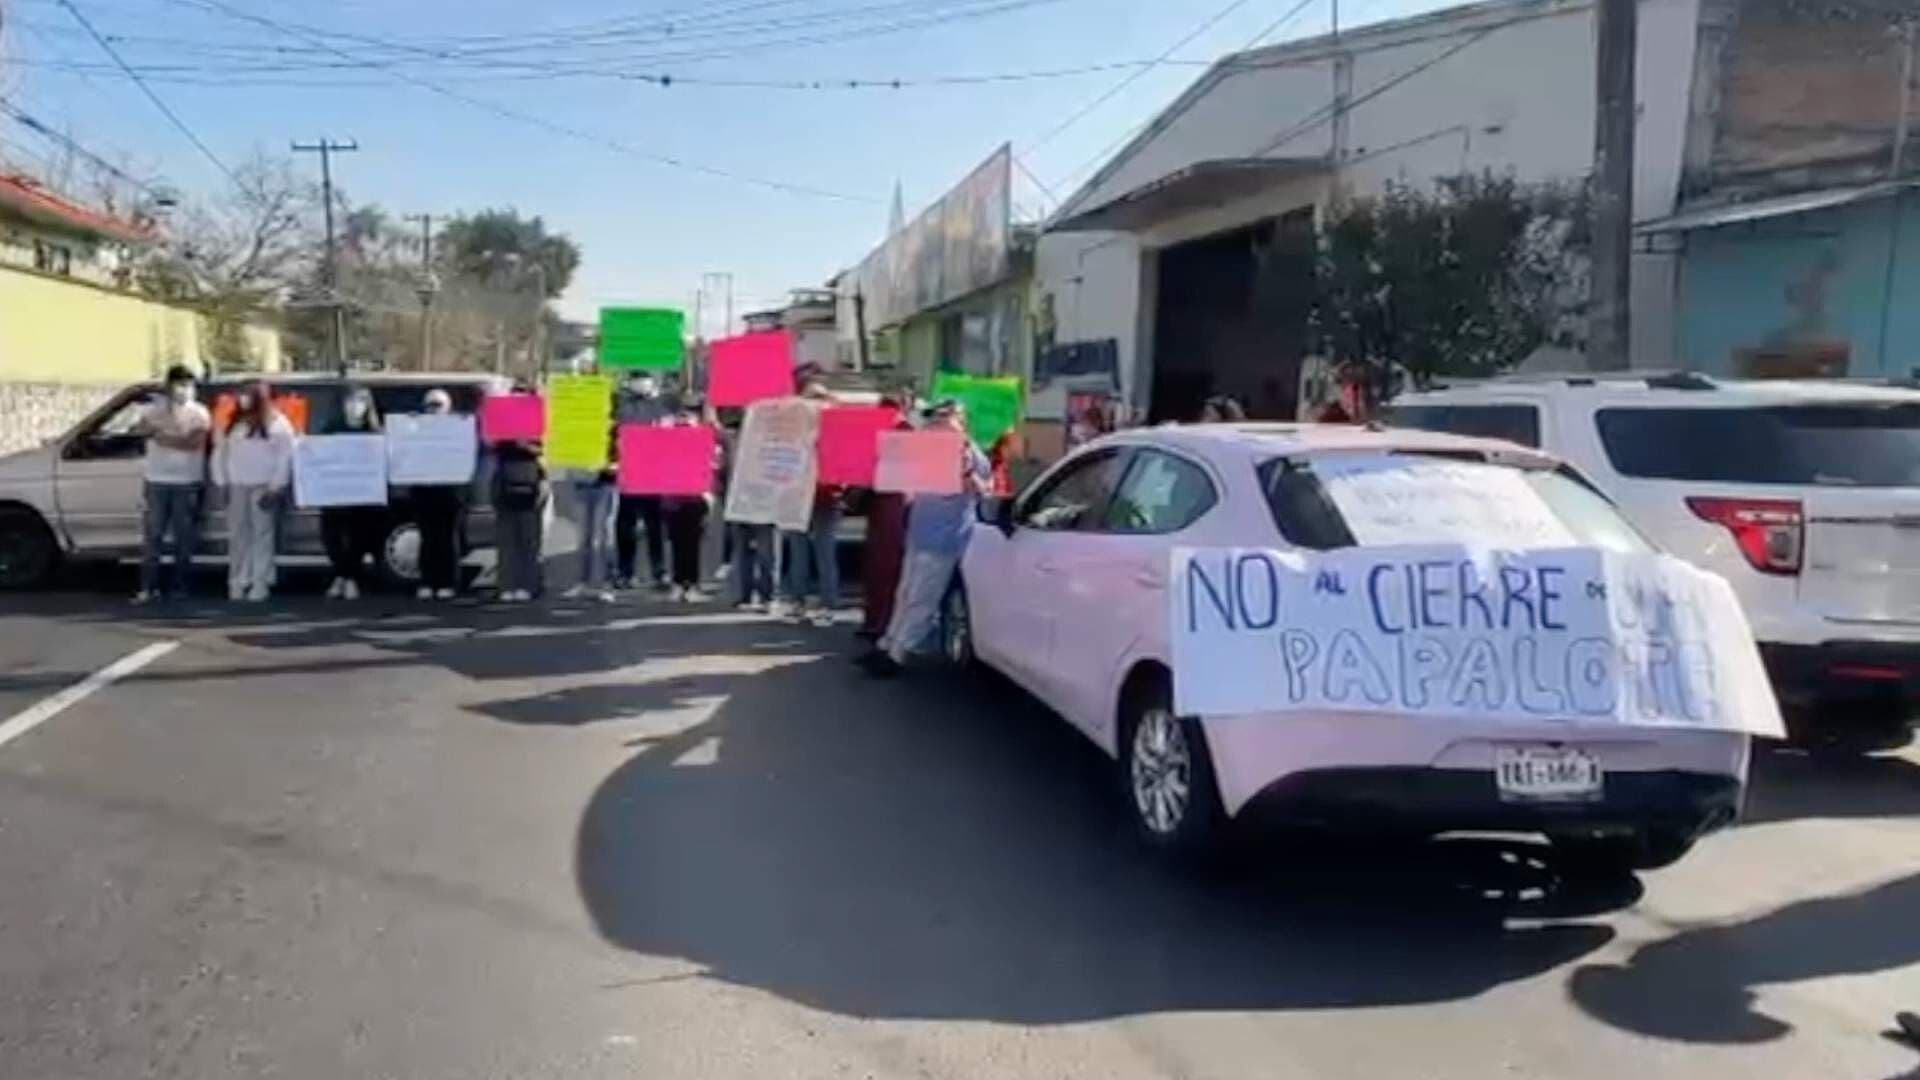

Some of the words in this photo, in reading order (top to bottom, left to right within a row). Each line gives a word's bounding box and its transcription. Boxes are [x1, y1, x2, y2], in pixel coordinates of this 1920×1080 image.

[1187, 553, 1278, 633] NO
[1314, 570, 1347, 596] AL
[1367, 560, 1566, 635] CIERRE
[1279, 627, 1719, 724] PAPALOTE
